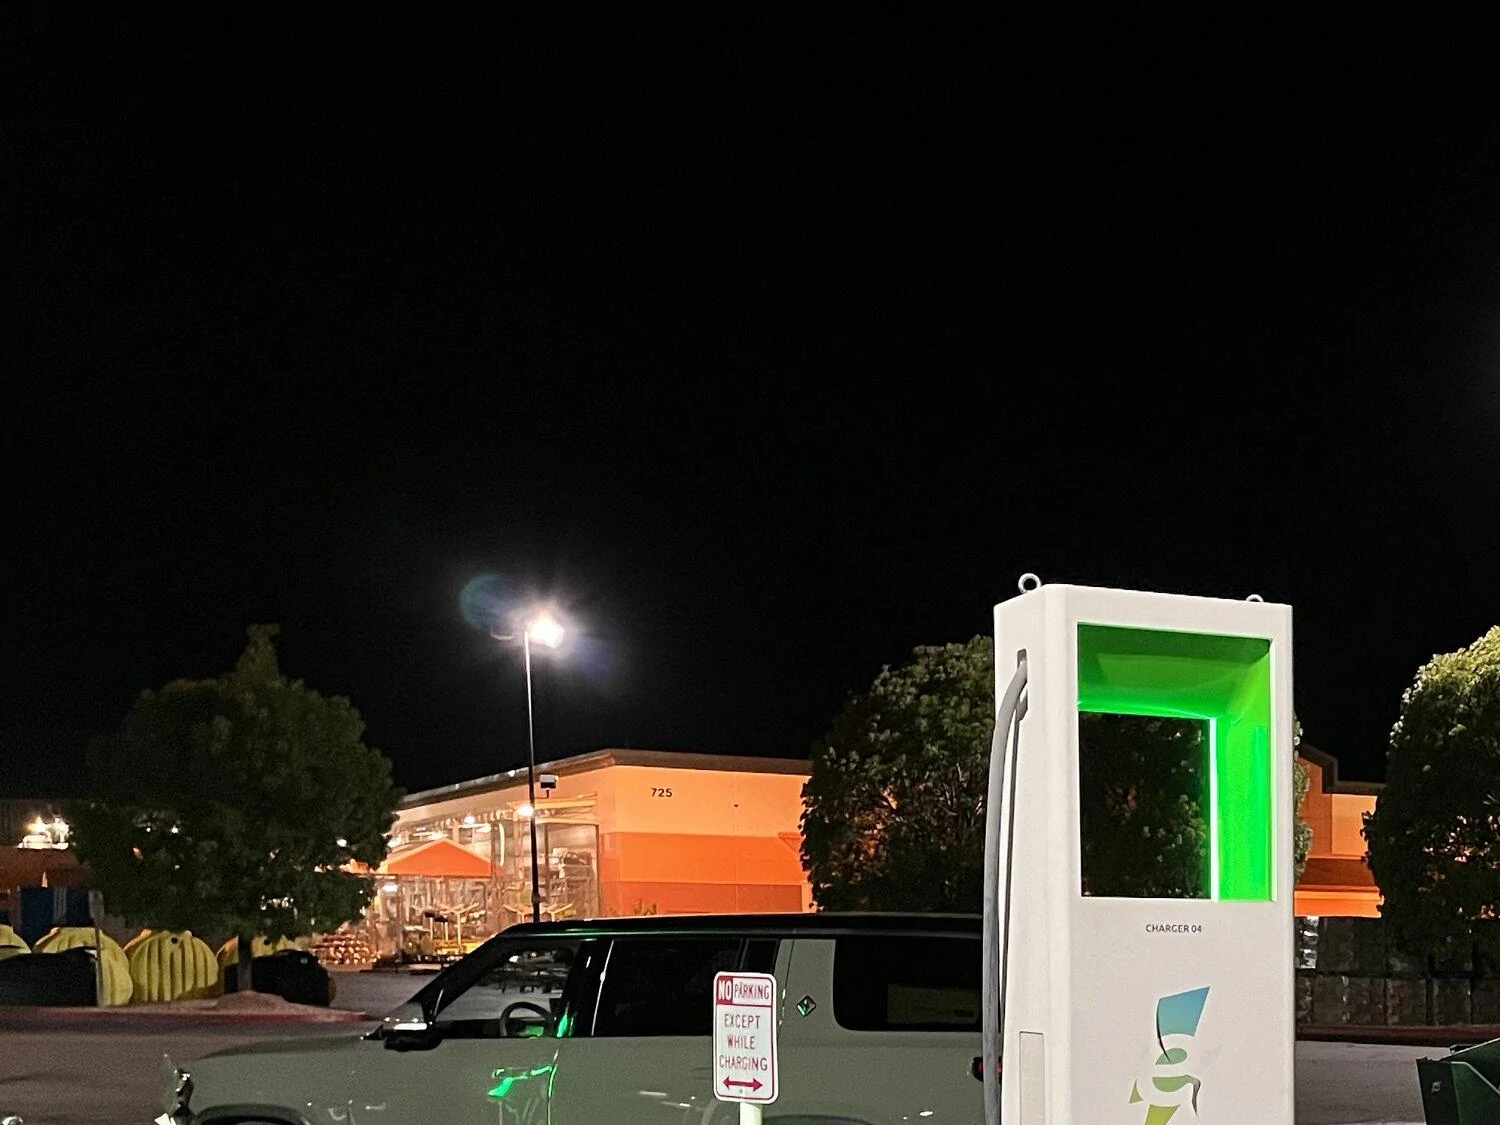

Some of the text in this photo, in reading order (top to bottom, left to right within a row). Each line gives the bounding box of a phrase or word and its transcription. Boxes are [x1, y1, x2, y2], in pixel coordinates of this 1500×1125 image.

[650, 787, 673, 798] 725
[1145, 924, 1202, 933] CHARGER 04
[718, 980, 770, 1001] NO PARKING
[724, 1013, 761, 1029] EXCEPT
[727, 1033, 756, 1050] WHILE
[719, 1054, 768, 1071] CHARGING
